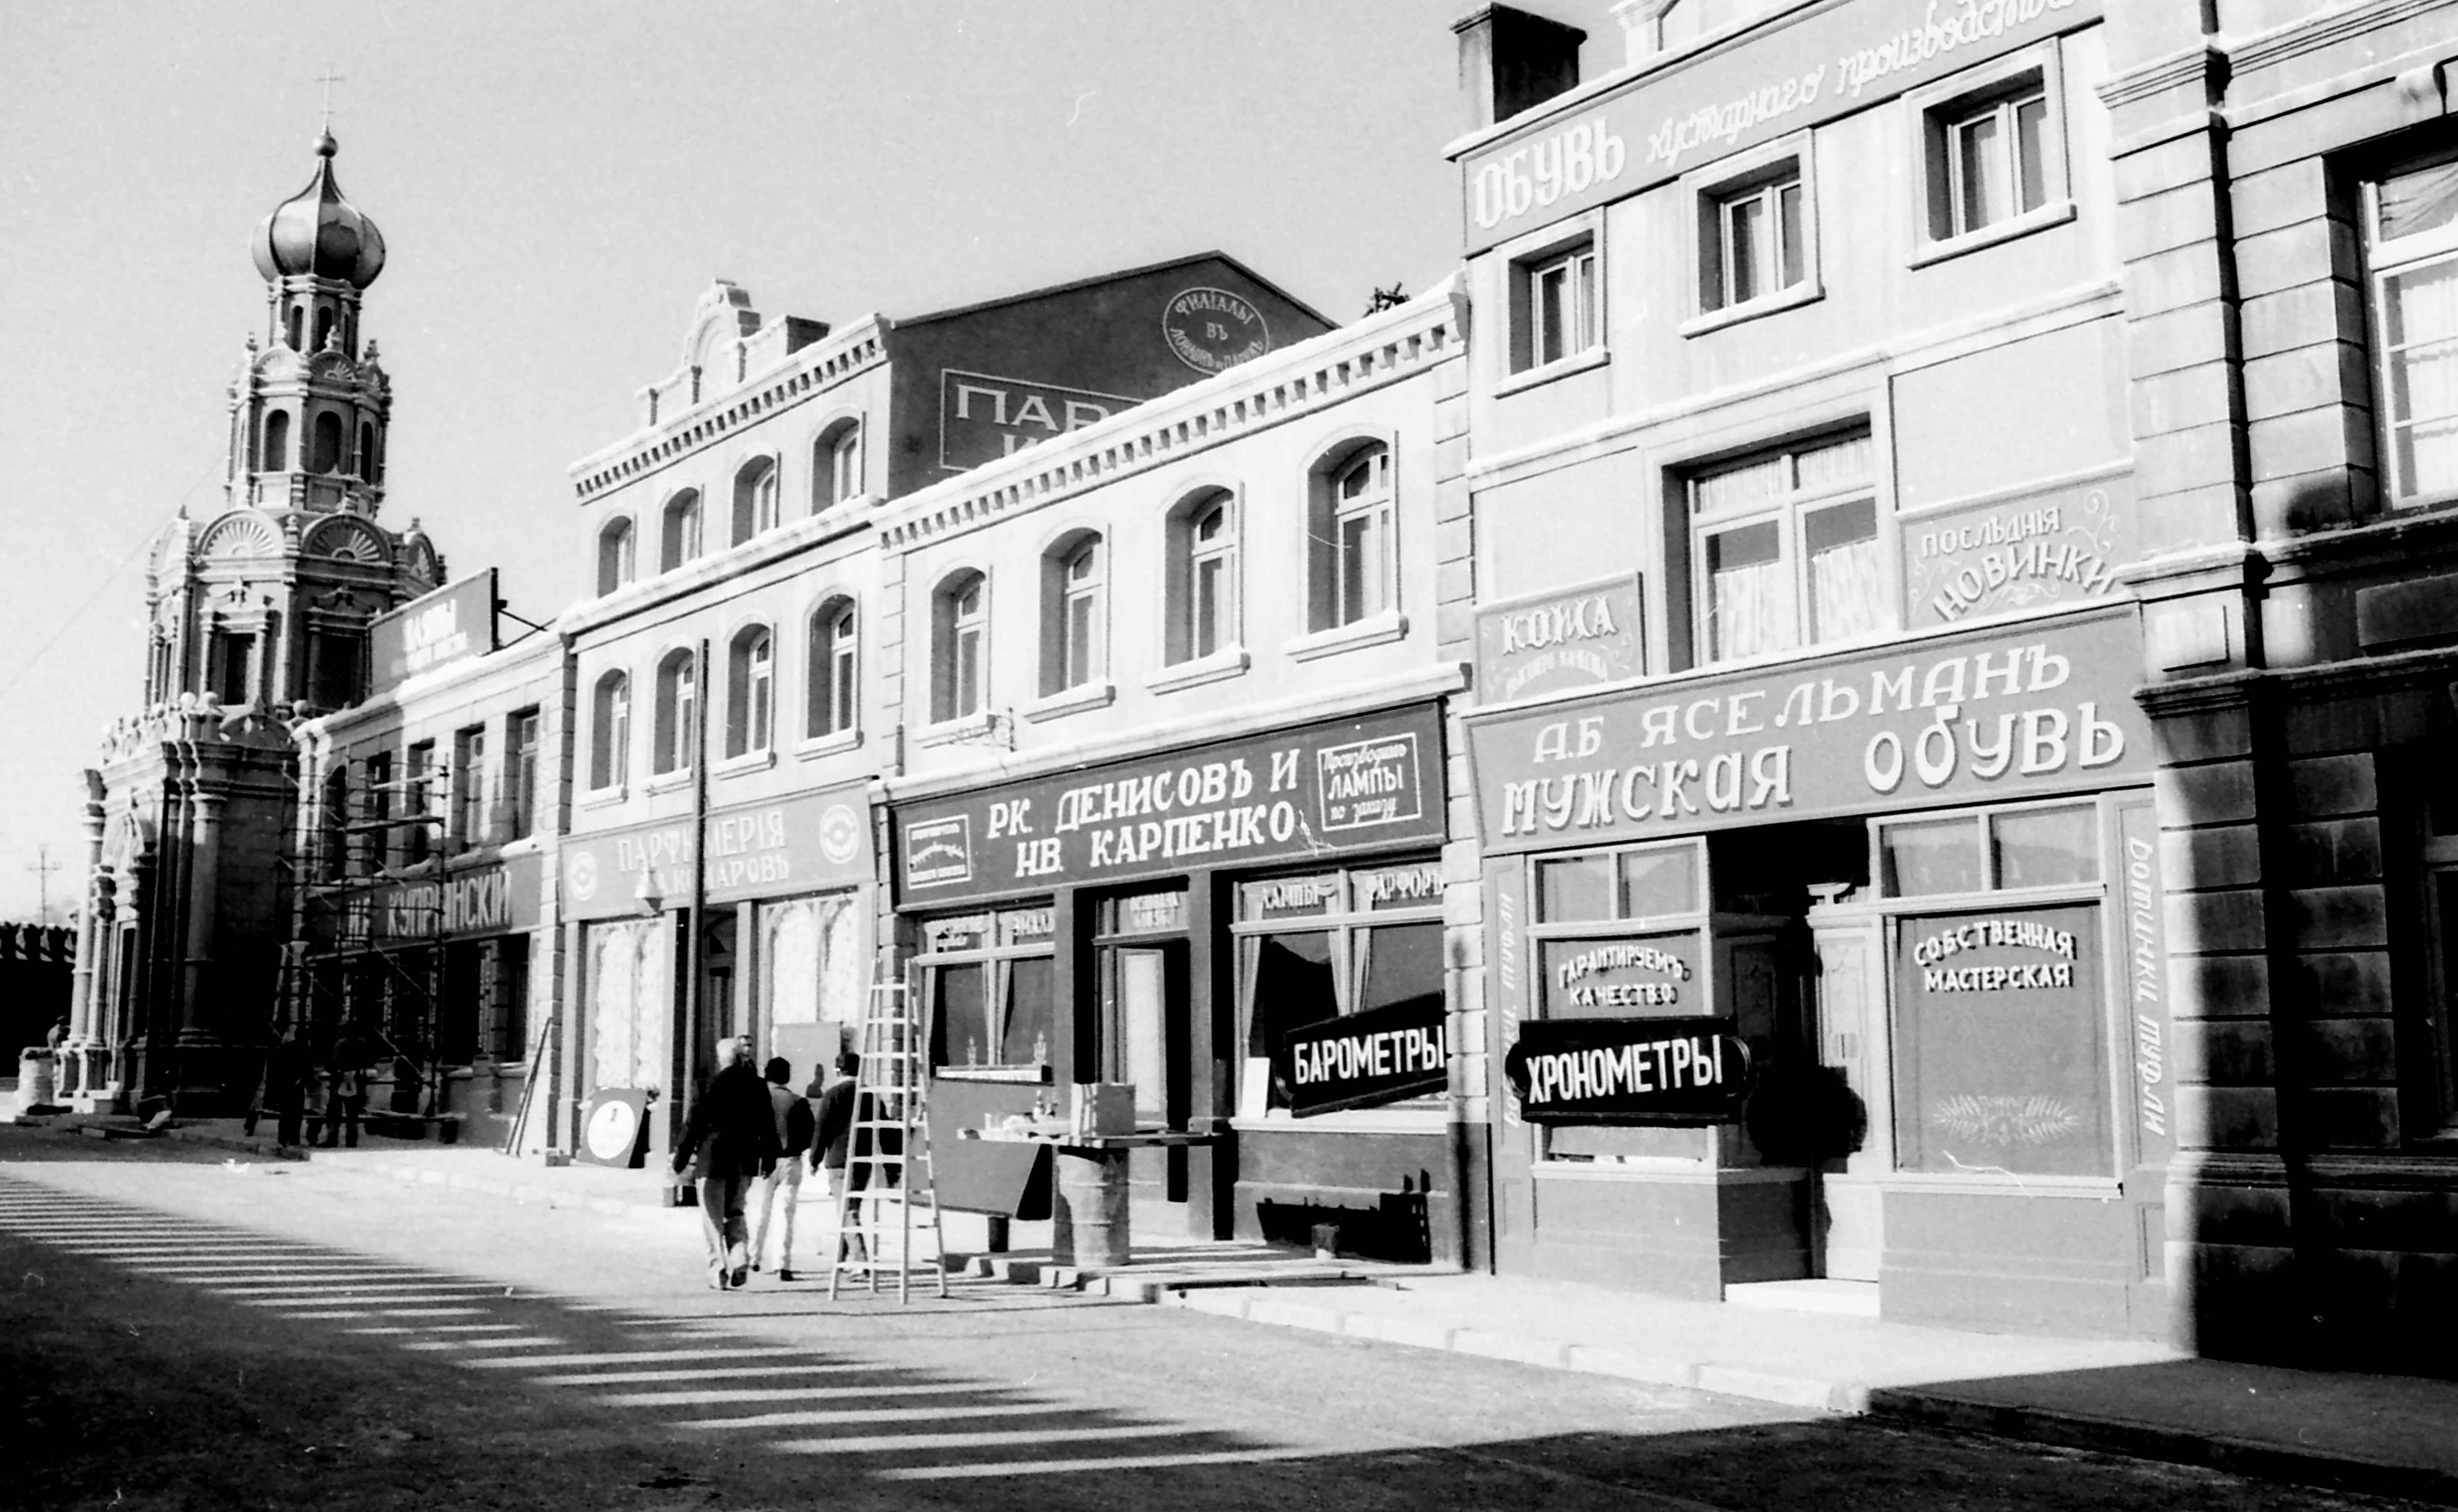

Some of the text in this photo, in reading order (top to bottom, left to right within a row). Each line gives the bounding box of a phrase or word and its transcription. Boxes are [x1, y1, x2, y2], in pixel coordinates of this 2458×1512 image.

[1473, 116, 1625, 229] ОБУВЬ
[1835, 0, 2075, 96] производст
[1206, 322, 1228, 340] ВЪ
[1933, 541, 2115, 621] НОВИНКИ
[1055, 758, 1253, 834] ДЕНИСОВЪ
[1269, 749, 1300, 792] И
[1328, 764, 1404, 800] ЛАМПЫ
[1089, 800, 1295, 868] КАРПЕНКО
[1914, 920, 2073, 966] СОБСТВЕННАЯ
[1570, 983, 1672, 1007] КАЧЕСТВО
[1924, 962, 2070, 992] МАСТЕРСКАЯ
[1294, 1025, 1444, 1084] БАРОМЕТРЫ
[1525, 1034, 1723, 1104] ХРОНОМЕТРЫ
